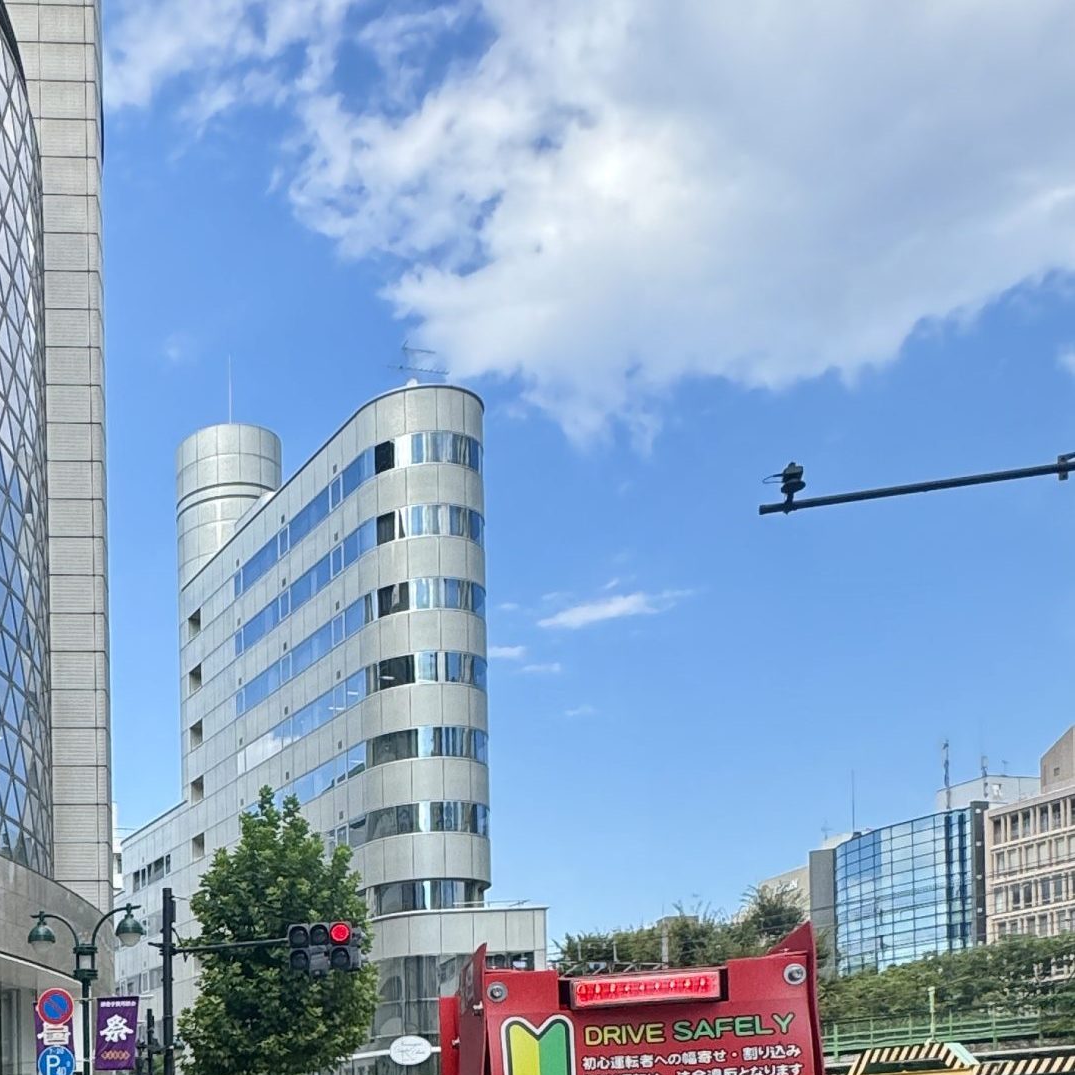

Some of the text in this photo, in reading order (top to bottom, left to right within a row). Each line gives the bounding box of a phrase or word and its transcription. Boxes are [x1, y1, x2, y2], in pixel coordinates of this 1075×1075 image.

[99, 1013, 134, 1043] 祭
[583, 1012, 796, 1047] DRIVE SAFELY
